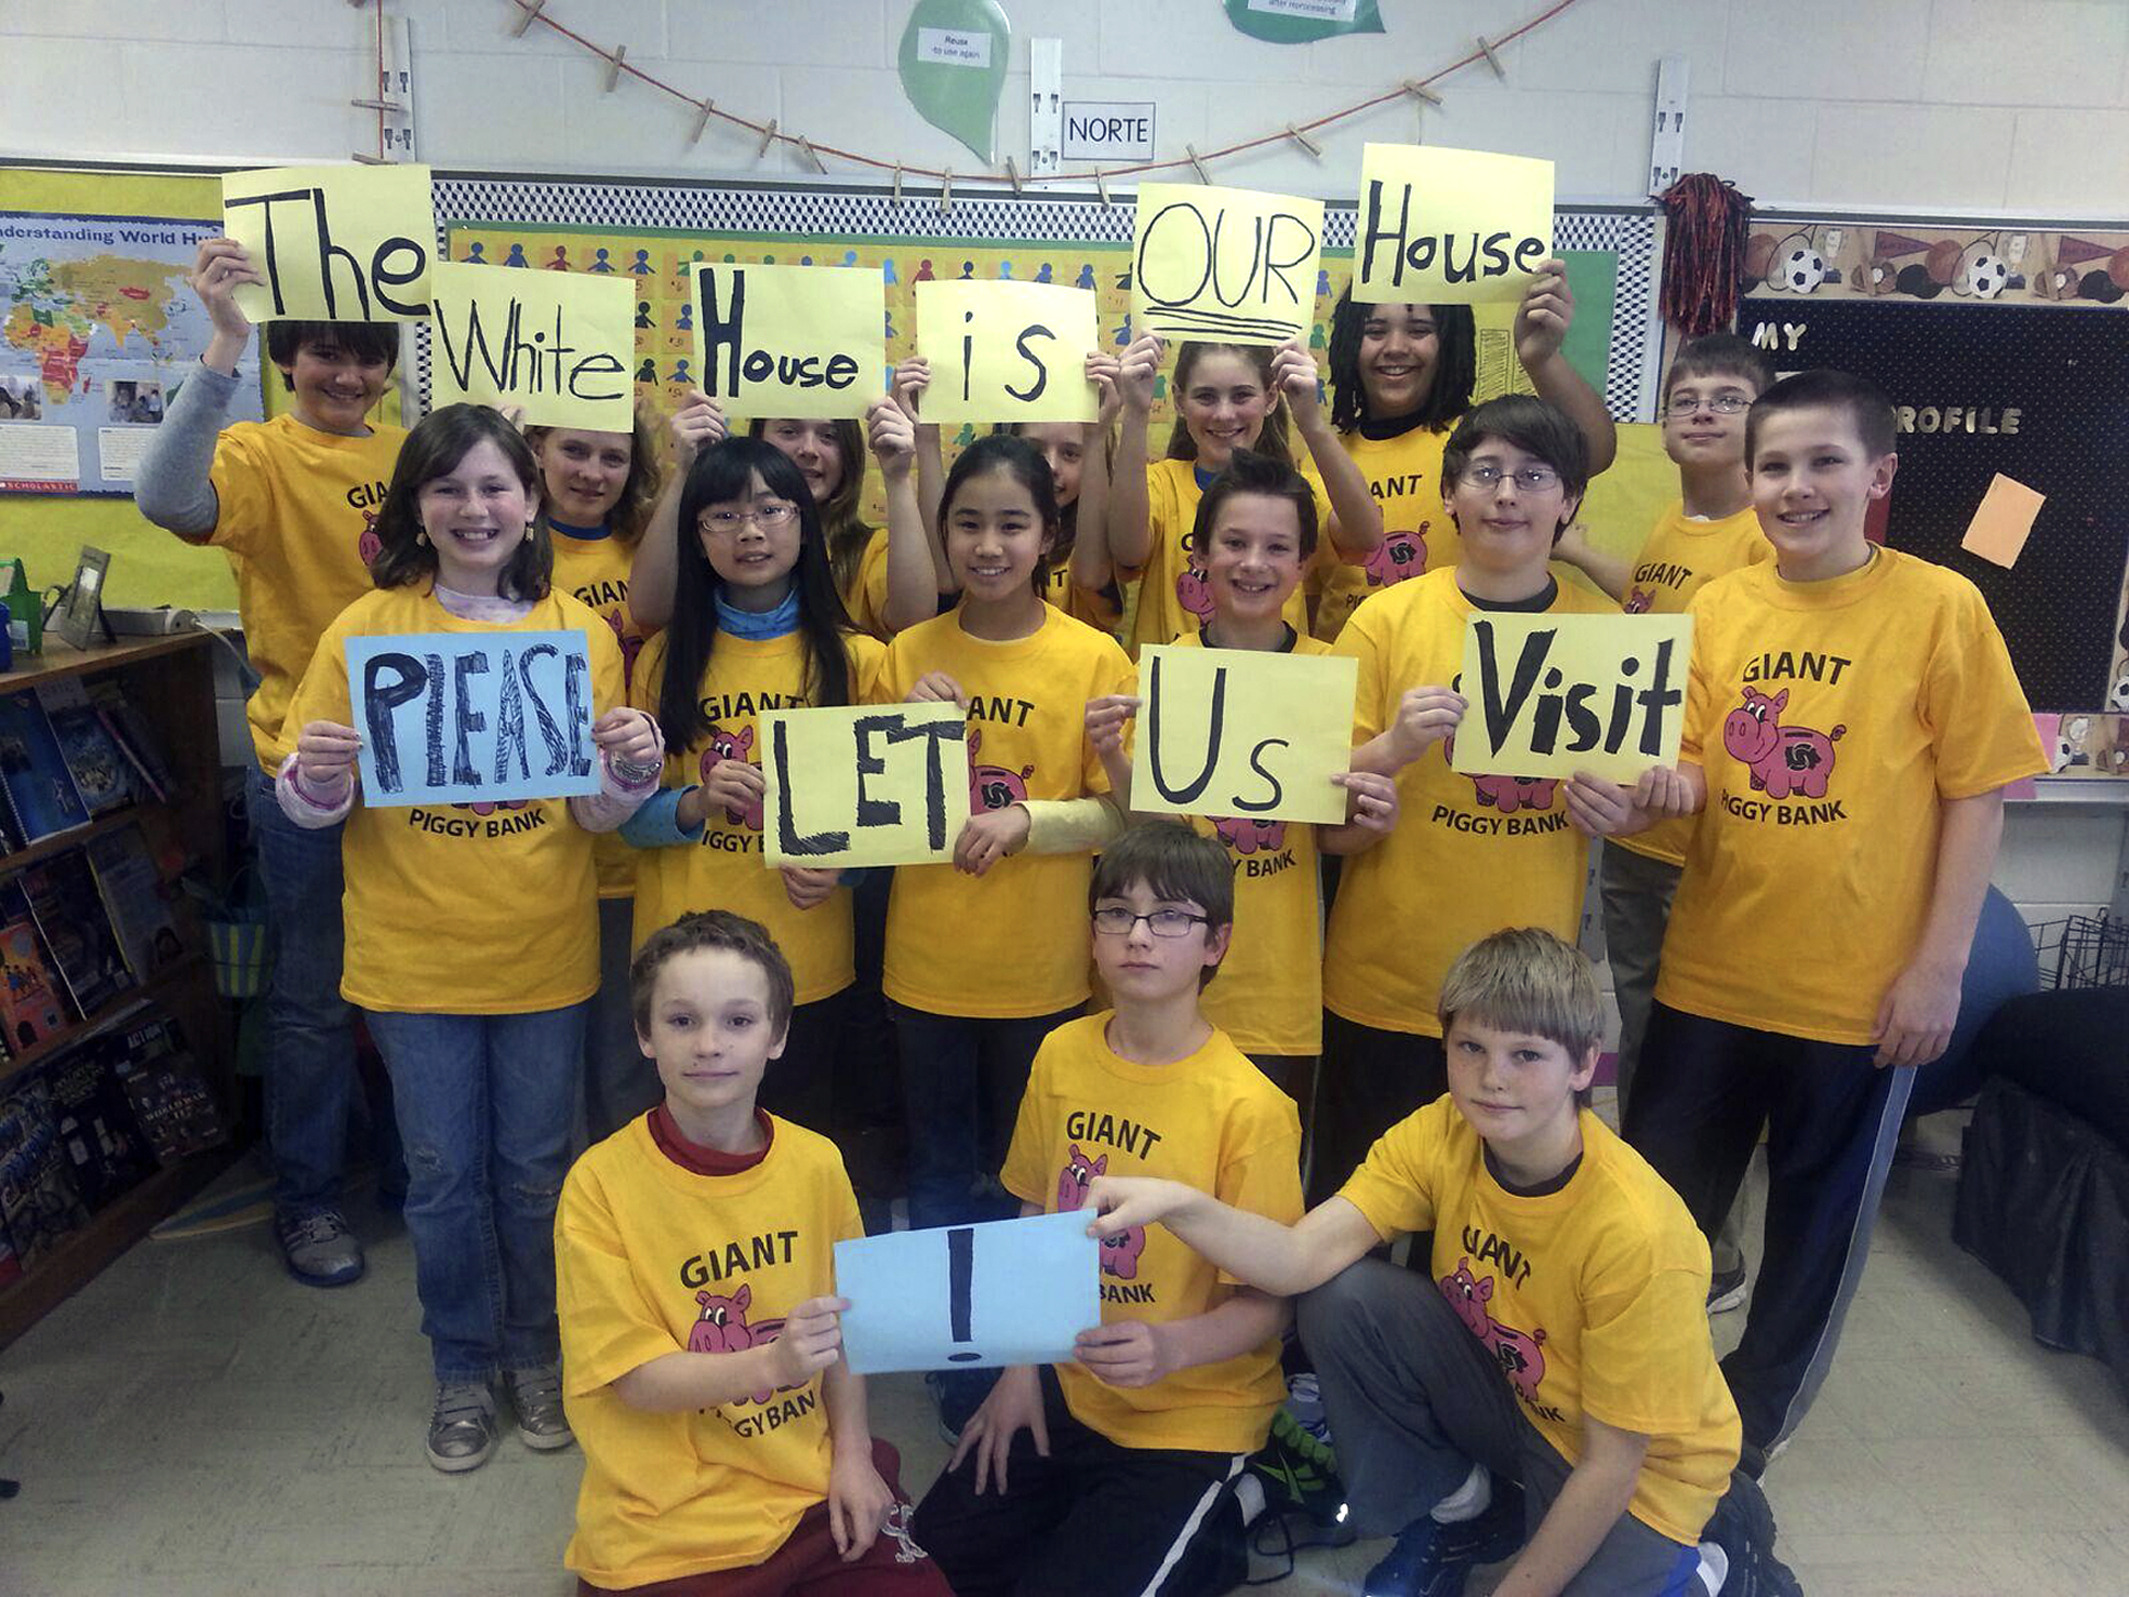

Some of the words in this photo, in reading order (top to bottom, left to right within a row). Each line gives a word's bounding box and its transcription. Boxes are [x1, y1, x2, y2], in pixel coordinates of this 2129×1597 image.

[1070, 118, 1149, 144] NORTE
[0, 224, 114, 246] derstanding
[119, 229, 176, 245] World
[1362, 180, 1545, 287] House
[224, 188, 431, 322] The
[1138, 202, 1315, 307] OUR
[434, 297, 626, 400] White
[700, 268, 858, 398] House
[1751, 321, 1808, 351] MY
[961, 311, 1058, 403] is
[1889, 404, 2022, 434] ROFILE
[7, 481, 76, 491] SCHOLASTIC
[346, 480, 388, 509] GIA
[1370, 474, 1423, 499] ANT
[1634, 562, 1693, 591] GIANT
[573, 580, 628, 608] GIAN
[1741, 650, 1852, 686] GIANT
[1473, 619, 1682, 759] Visit
[966, 696, 1036, 728] ANT
[1149, 656, 1290, 812] Us
[772, 712, 967, 856] LET
[408, 808, 480, 838] PIGGY
[485, 808, 546, 838] BANK
[1431, 804, 1502, 836] PIGGY
[1506, 810, 1570, 837] BANK
[1777, 799, 1848, 827] BANK
[701, 830, 751, 854] IGGY
[1246, 849, 1298, 878] BANK
[1066, 1111, 1162, 1161] GIANT
[680, 1230, 799, 1290] GIANT
[946, 1227, 982, 1362] !
[766, 1390, 816, 1431] BAN
